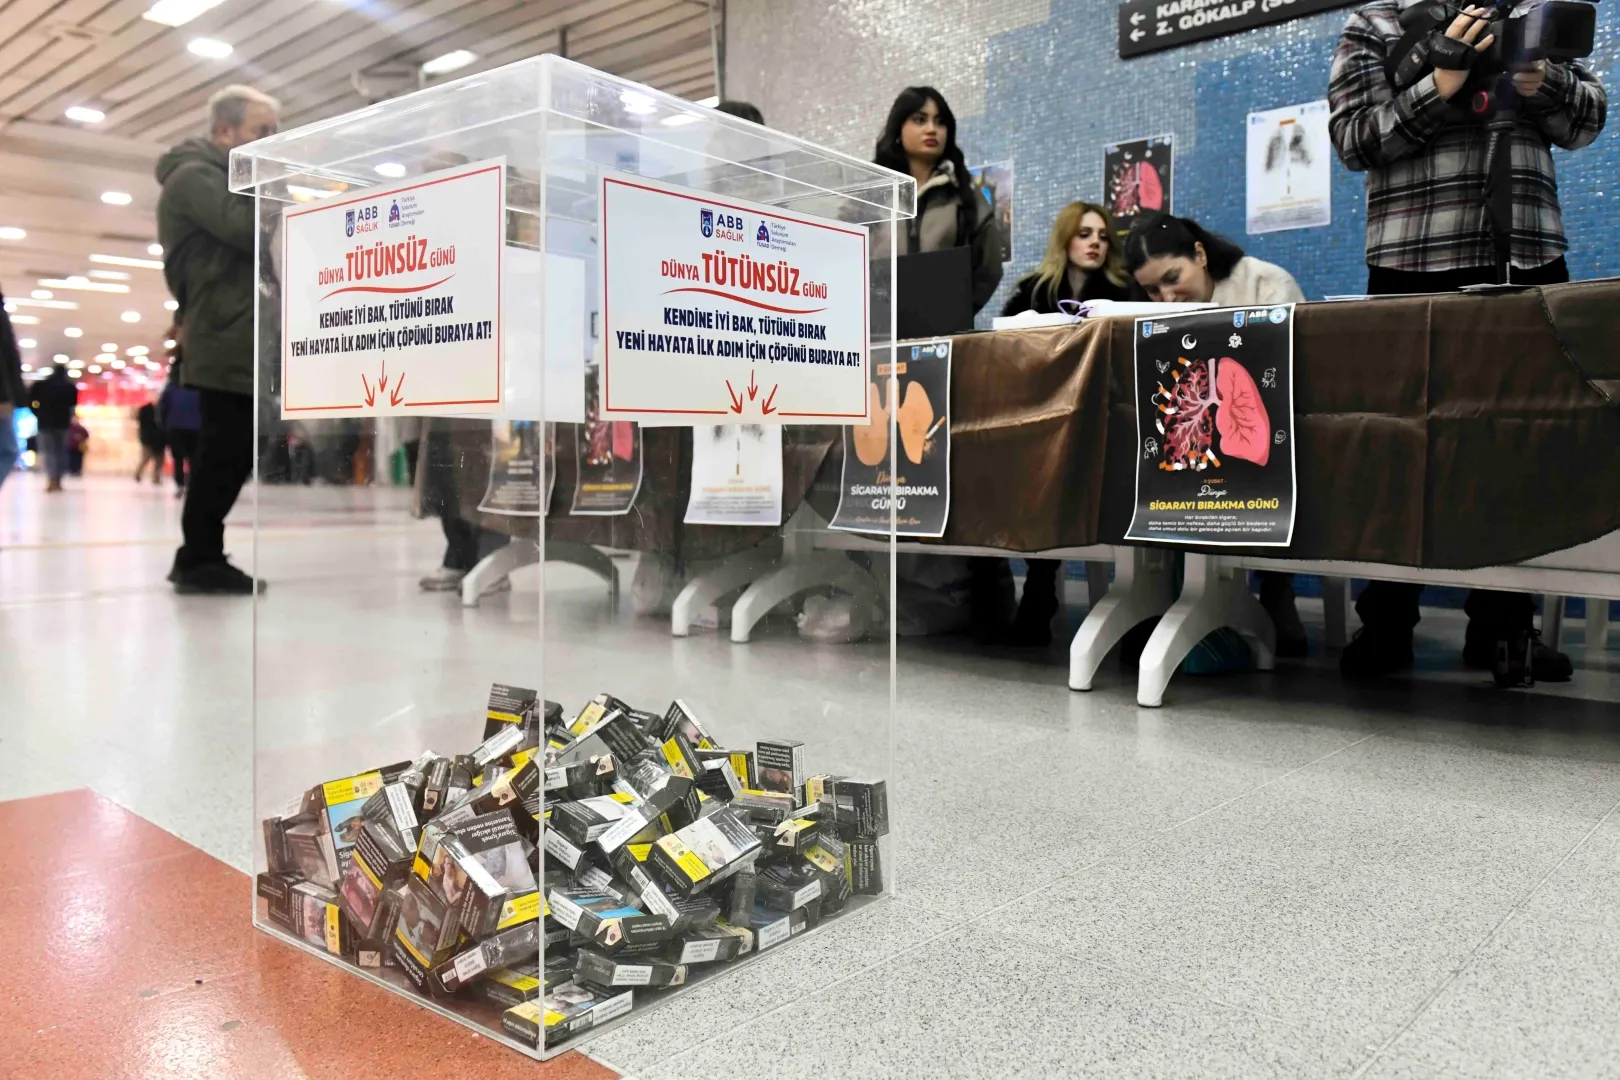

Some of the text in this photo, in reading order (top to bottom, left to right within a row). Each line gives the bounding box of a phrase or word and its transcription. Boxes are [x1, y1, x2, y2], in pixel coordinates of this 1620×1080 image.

[1156, 21, 1174, 36] Z.
[1179, 0, 1256, 30] GÖKALP
[356, 222, 379, 234] SAĞLIK
[358, 206, 378, 222] ABB
[717, 214, 743, 230] ABB
[716, 229, 744, 242] SAĞLIK
[319, 235, 455, 285] DÜNYA TÜTÜNSÜZ GÜNÜ
[661, 250, 828, 299] DÜNYA TÜTÜNSÜZ GÜNÜ
[320, 296, 454, 329] KENDİNE İYİ BAK, TÜTÜNÜ BIRAK
[664, 307, 826, 340] KENDİNE İYİ BAK, TÜTÜNÜ BIRAK
[291, 320, 492, 357] YENİ HAYATA İLK ADIM İÇİN ÇÖPÜNÜ BURAYA AT!
[616, 329, 860, 367] YENİ HAYATA İLK ADIM İÇİN ÇÖPÜNÜ BURAYA AT!
[1149, 498, 1279, 510] SİGARAYI BIRAKMA GÜNÜ
[1197, 485, 1227, 498] Dünya
